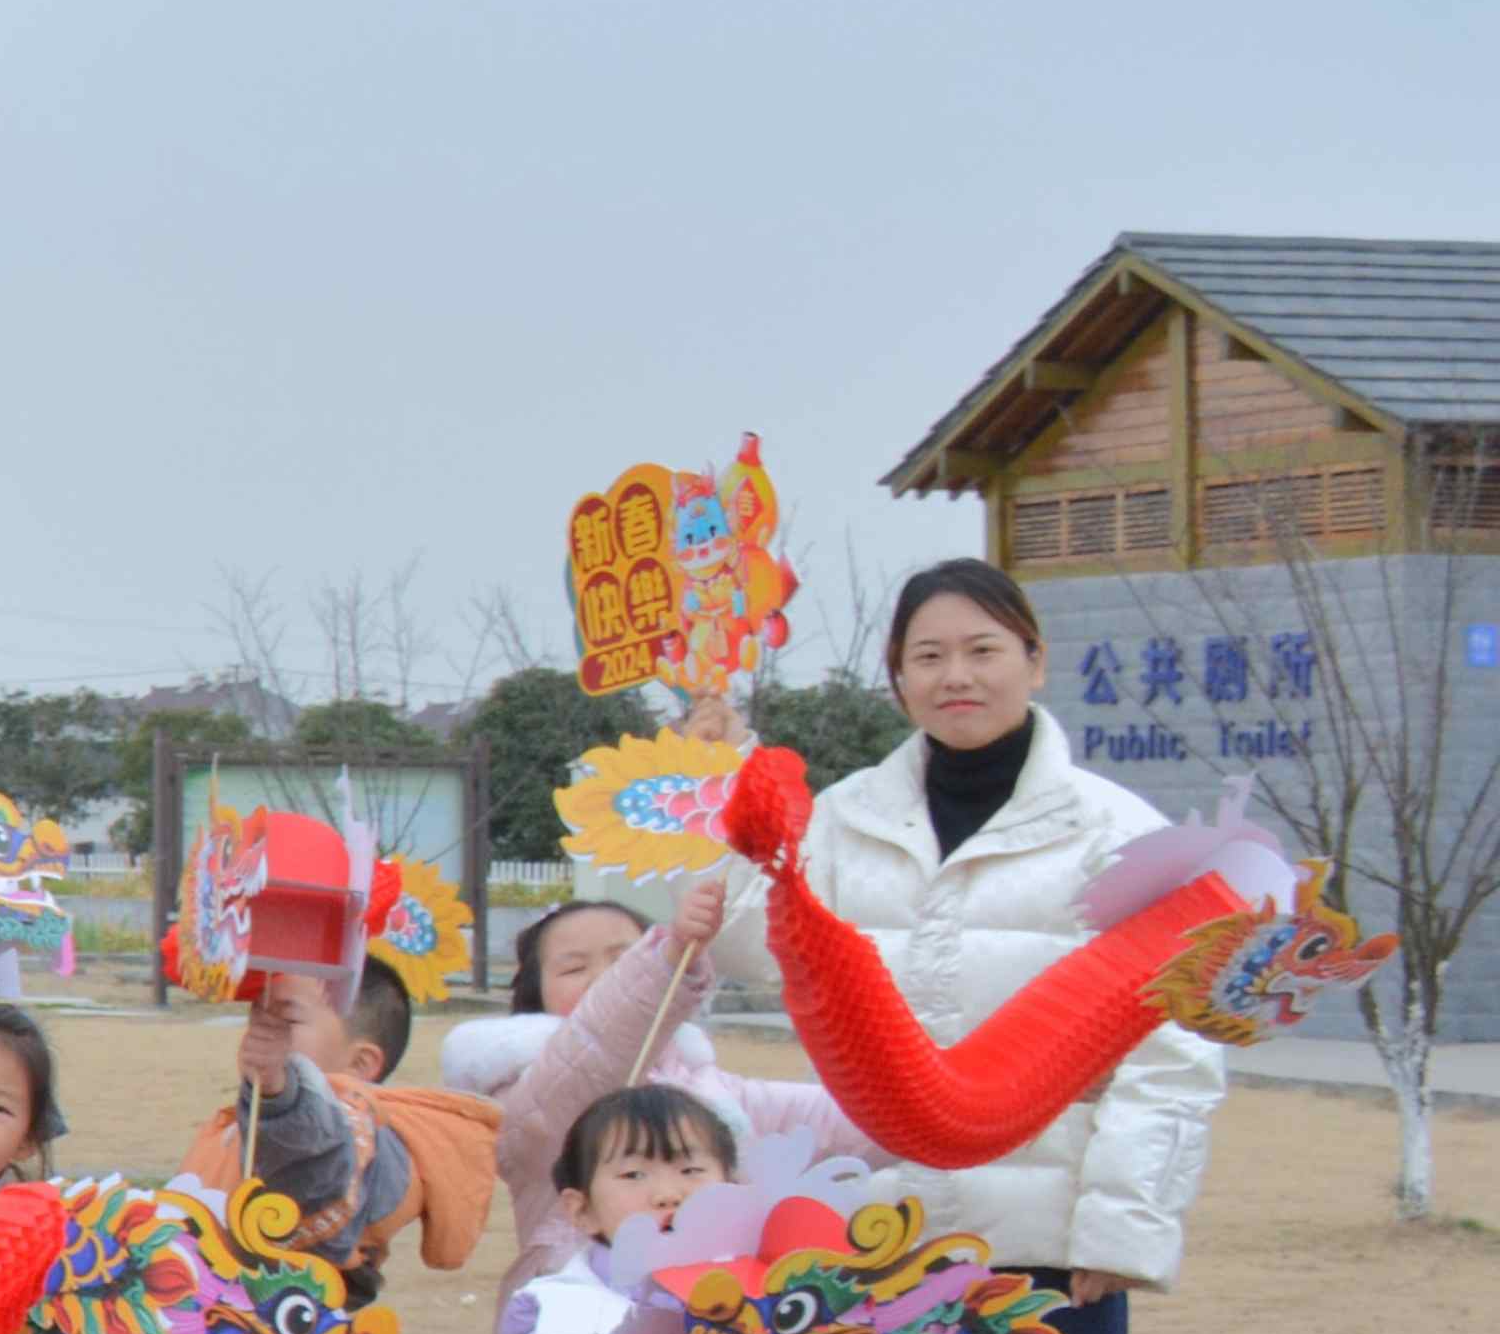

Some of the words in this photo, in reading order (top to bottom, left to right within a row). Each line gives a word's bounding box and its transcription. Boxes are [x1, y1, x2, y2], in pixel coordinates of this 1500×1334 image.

[573, 493, 660, 569] 新春
[601, 641, 652, 687] 2024
[1084, 723, 1188, 762] Public
[1218, 720, 1312, 759] Toilet
